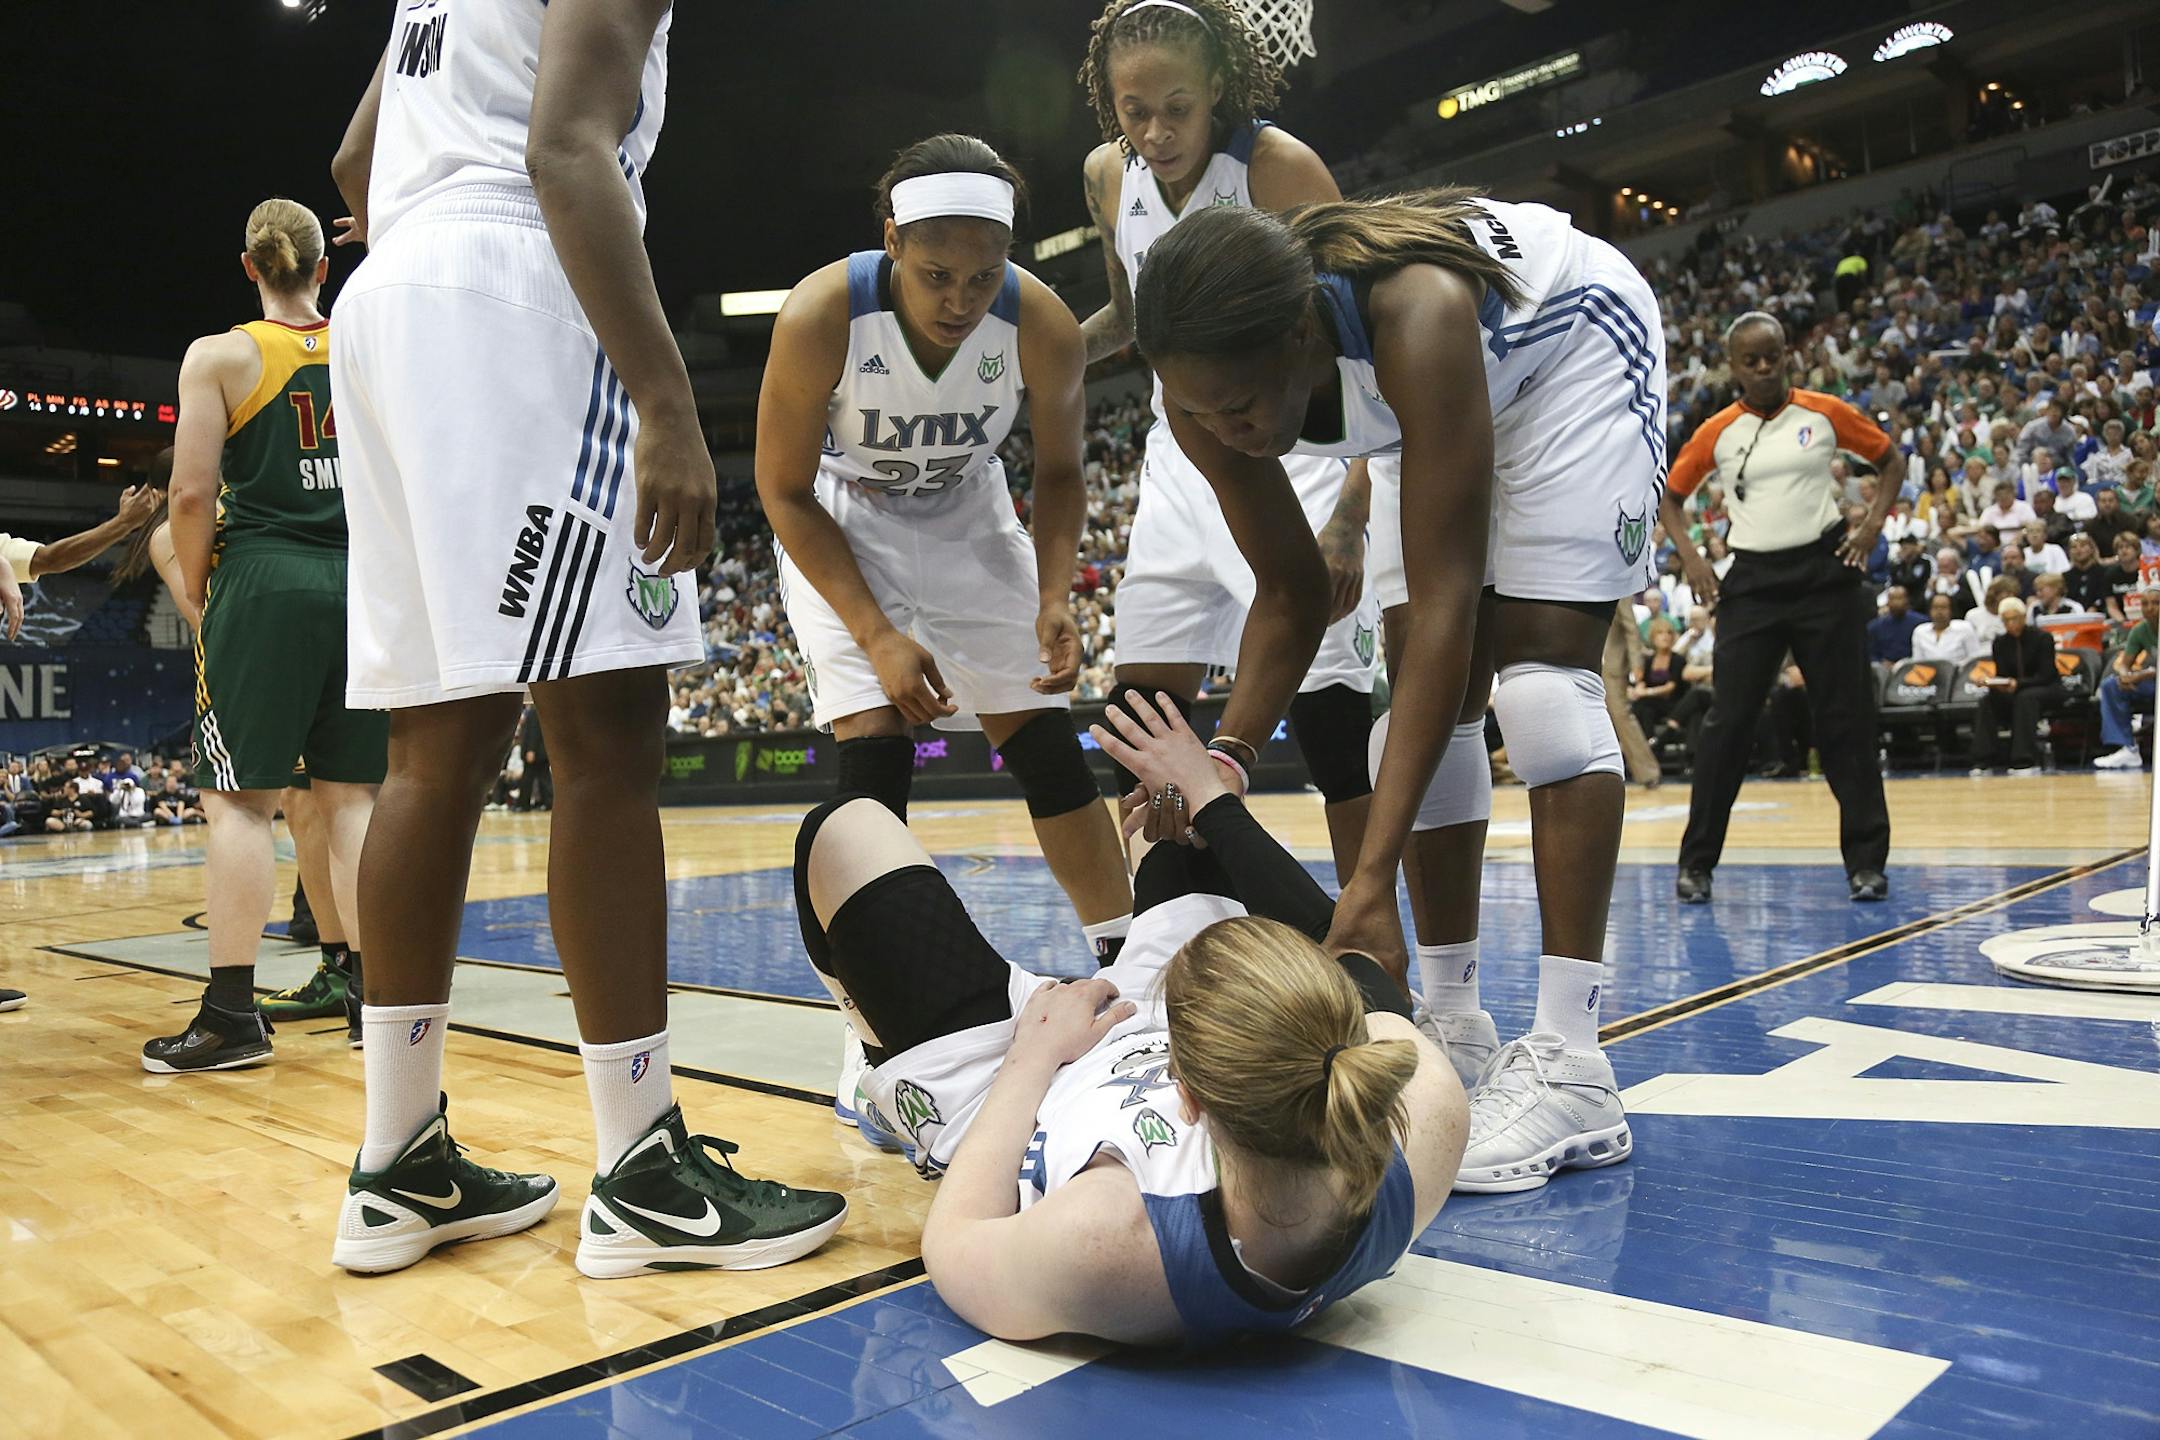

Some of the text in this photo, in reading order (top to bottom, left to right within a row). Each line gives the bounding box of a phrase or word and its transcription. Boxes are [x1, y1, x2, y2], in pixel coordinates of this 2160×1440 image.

[1457, 80, 1500, 112] TMG
[859, 365, 890, 375] adidas
[858, 405, 999, 451] LYNX
[857, 453, 973, 497] 23
[498, 504, 554, 618] WNBA
